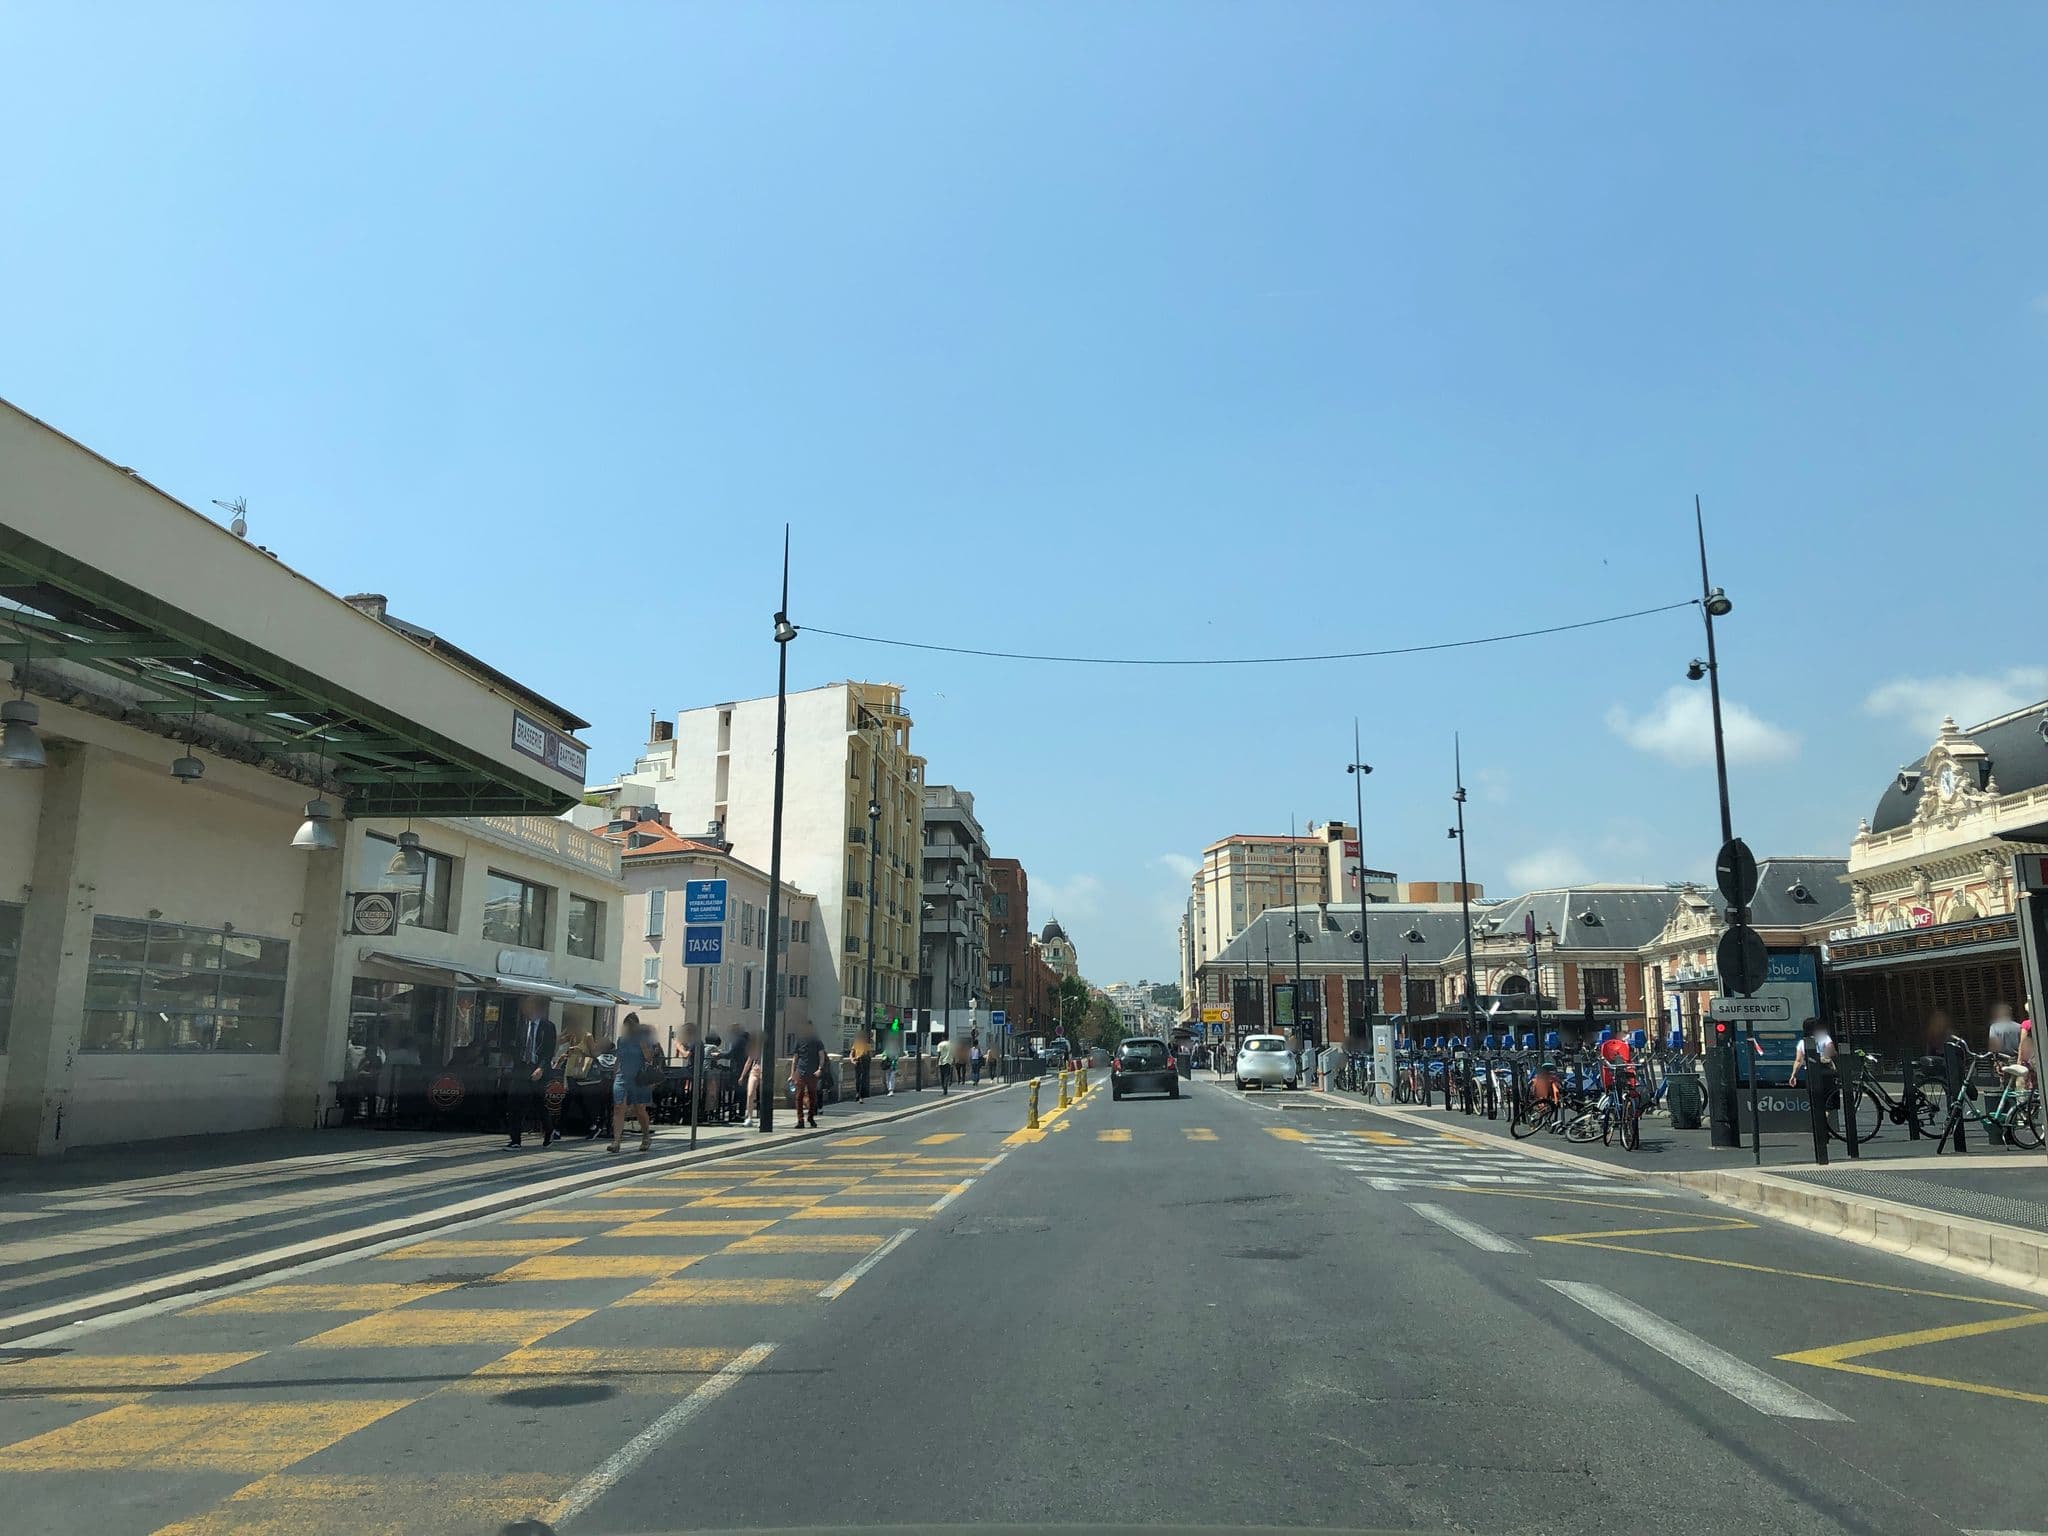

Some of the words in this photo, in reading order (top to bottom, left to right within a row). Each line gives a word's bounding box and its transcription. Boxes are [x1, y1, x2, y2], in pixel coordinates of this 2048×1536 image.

[517, 722, 542, 750] BRASSERIE
[688, 939, 720, 951] TAXIS
[1719, 1005, 1741, 1013] SAUF
